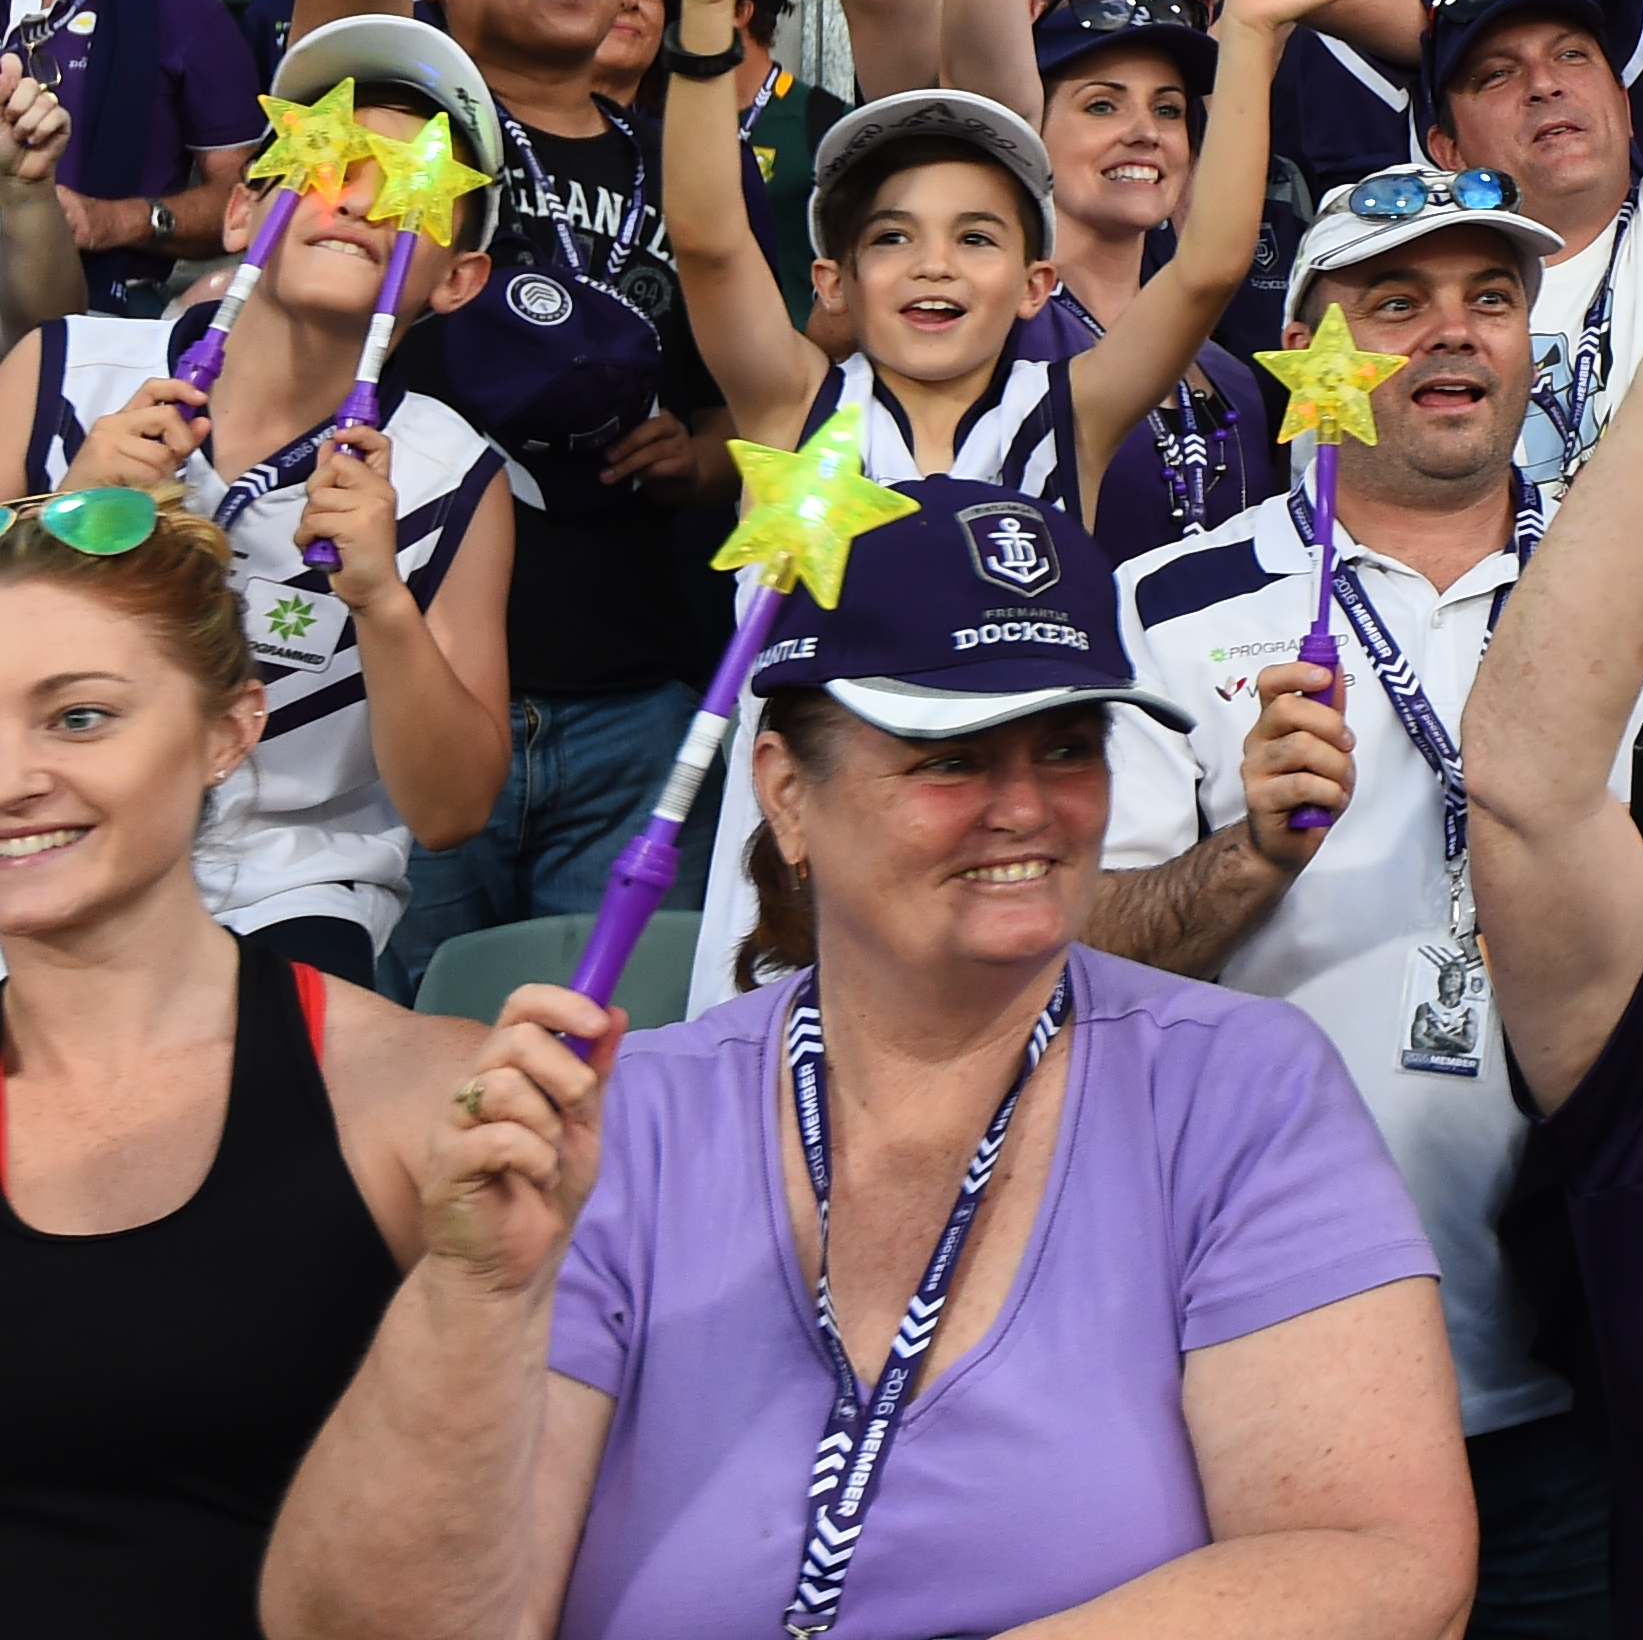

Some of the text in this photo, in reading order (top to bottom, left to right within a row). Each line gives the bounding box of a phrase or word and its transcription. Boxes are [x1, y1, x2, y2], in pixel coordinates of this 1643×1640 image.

[633, 280, 659, 301] 94
[1576, 355, 1591, 404] MEMBER
[281, 442, 315, 467] 2016
[984, 608, 1071, 623] FREMANTLE
[1333, 574, 1393, 659] 2016 MEMBER
[951, 621, 1091, 652] DOCKERS
[1228, 633, 1350, 660] PROGRAD
[1422, 713, 1450, 755] DOCKERS
[1430, 1054, 1478, 1068] MEMBER
[797, 1062, 823, 1145] MEMBER
[924, 1225, 961, 1293] DOCKERS
[837, 1367, 910, 1519] 2016 MEMBER
